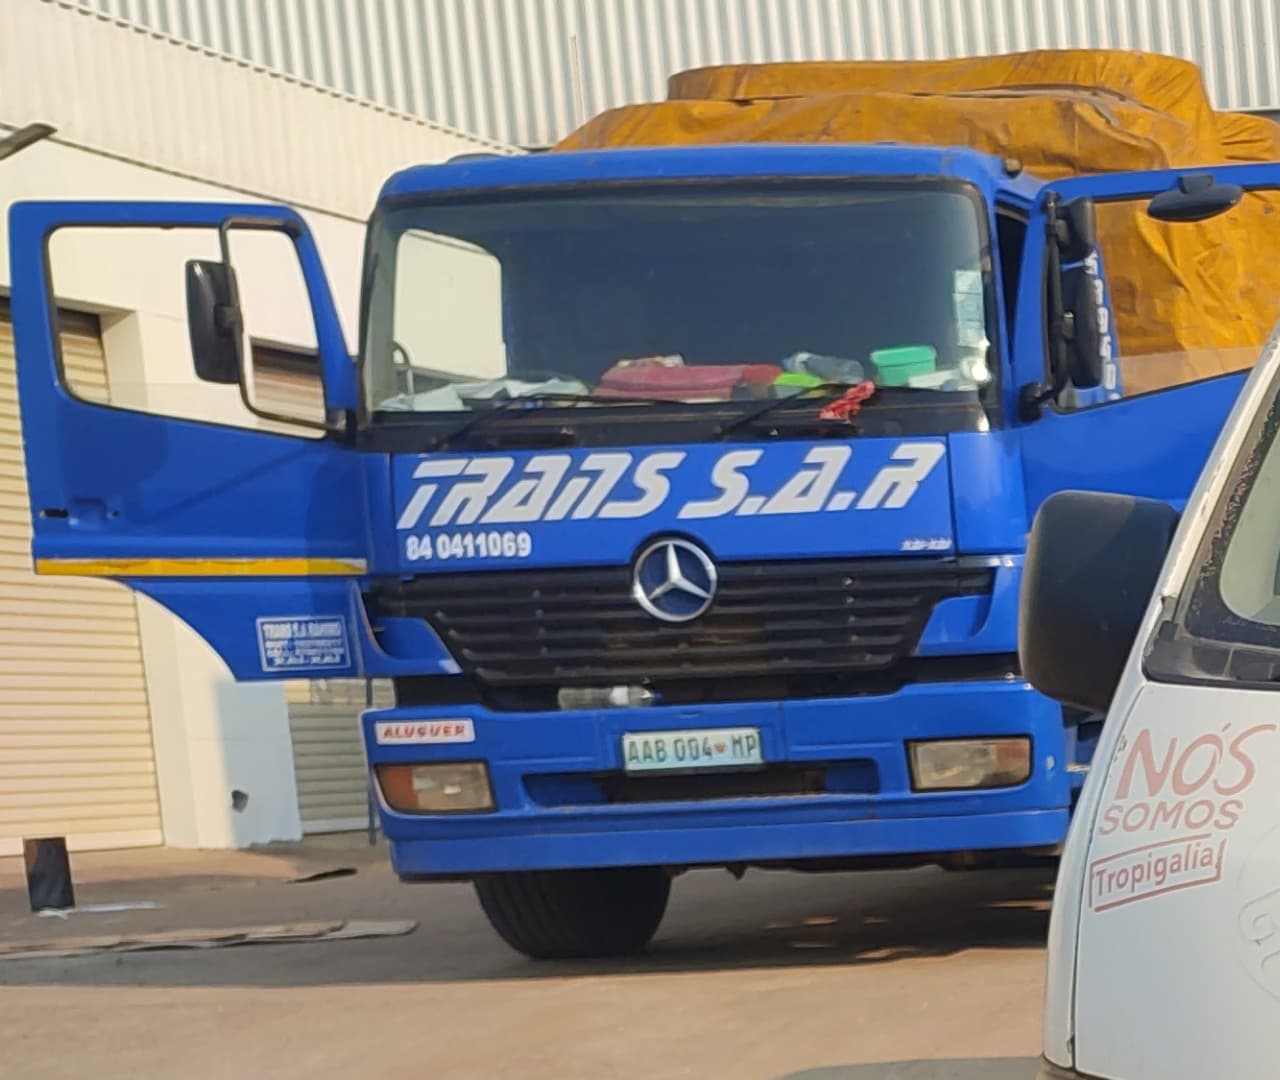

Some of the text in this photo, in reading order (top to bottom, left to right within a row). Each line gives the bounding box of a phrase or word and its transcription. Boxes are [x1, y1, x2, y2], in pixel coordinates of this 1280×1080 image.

[396, 450, 686, 530] TRANS
[406, 530, 532, 560] 84 0411069
[628, 739, 668, 763] AAB
[673, 737, 713, 762] 004
[1100, 799, 1244, 836] SOMOS
[1095, 838, 1214, 897] Tropigalia
